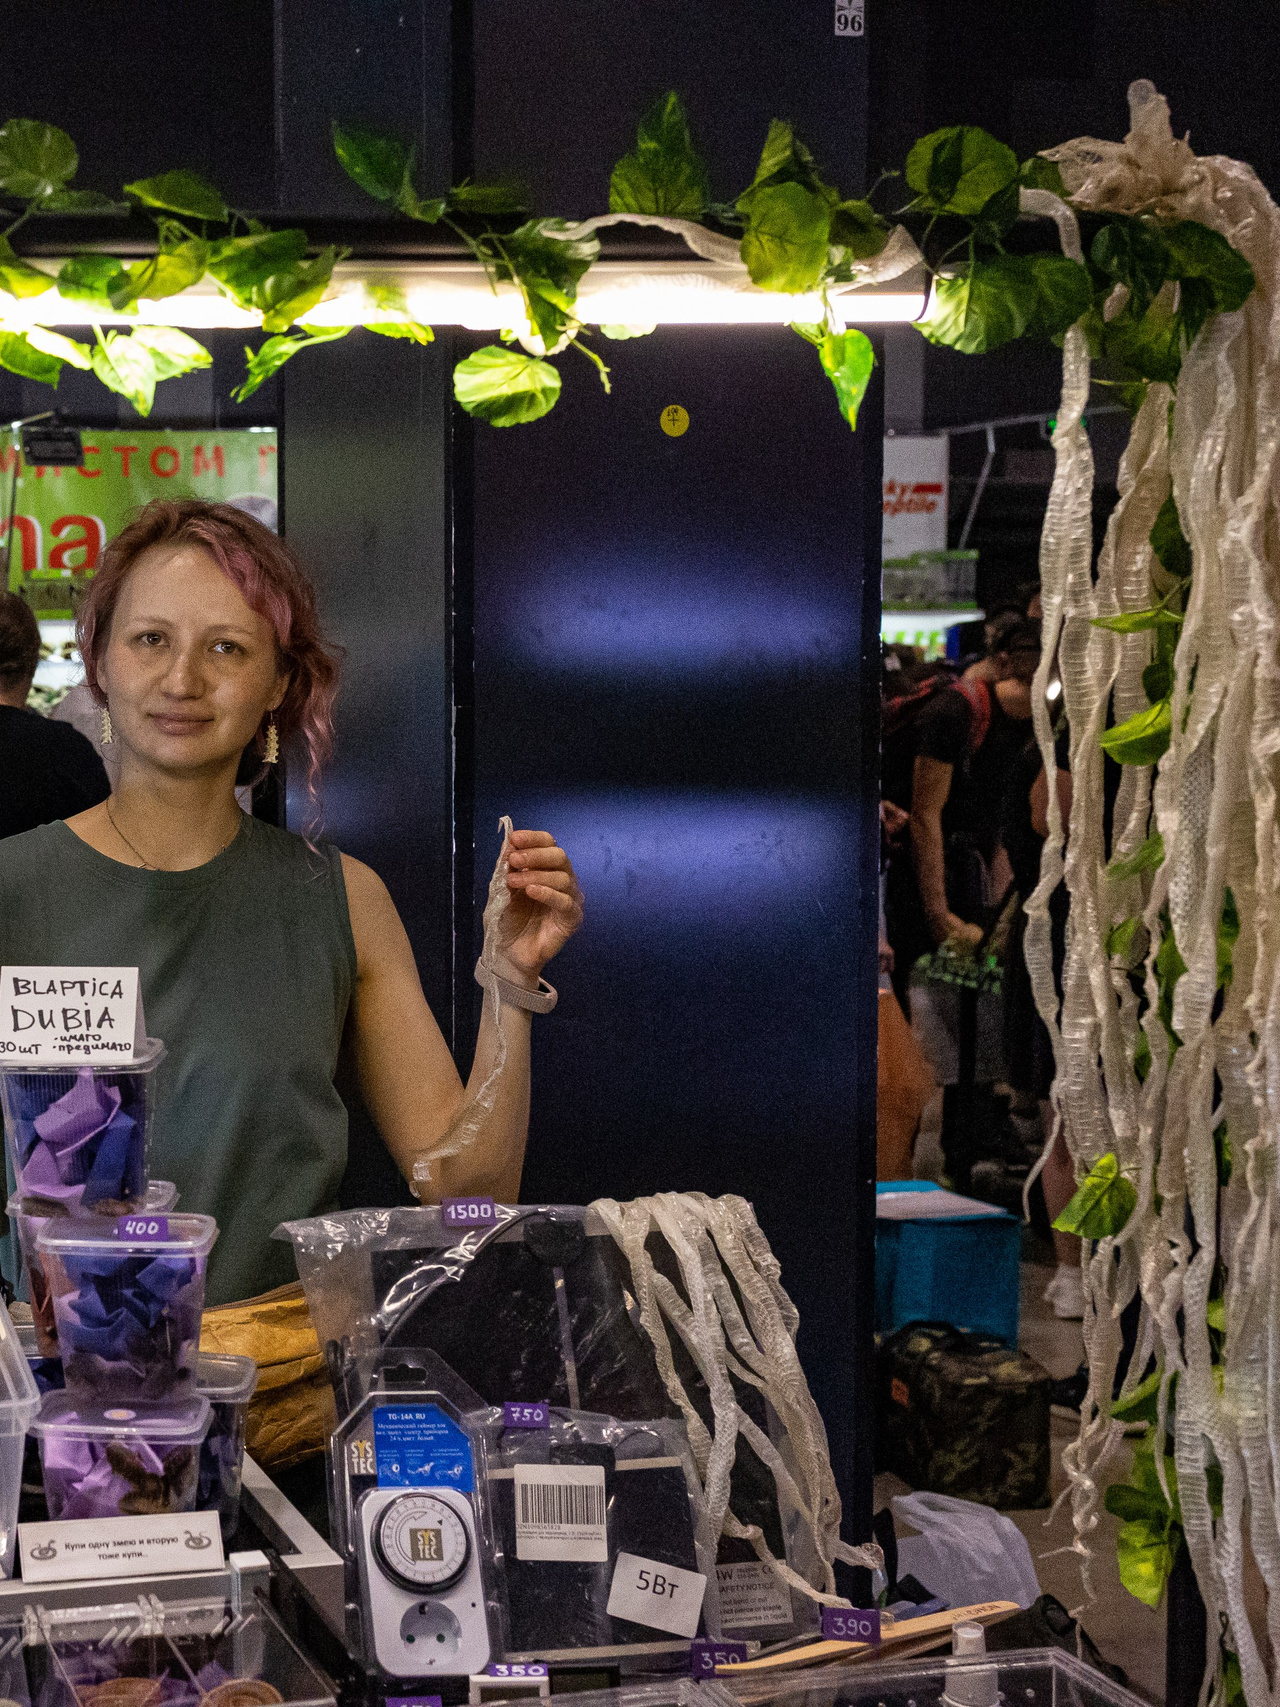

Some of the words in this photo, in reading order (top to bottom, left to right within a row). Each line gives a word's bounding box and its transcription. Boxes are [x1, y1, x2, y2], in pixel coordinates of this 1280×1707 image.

[837, 14, 862, 32] 96
[447, 1203, 492, 1219] 1500
[125, 1220, 159, 1235] 400
[511, 1407, 544, 1421] 750
[351, 1440, 373, 1458] SYS
[352, 1458, 374, 1474] TEC
[417, 1530, 437, 1546] SYS
[418, 1545, 438, 1559] TEC
[636, 1570, 679, 1599] 5Вт
[833, 1617, 872, 1637] 390
[495, 1664, 545, 1677] 350
